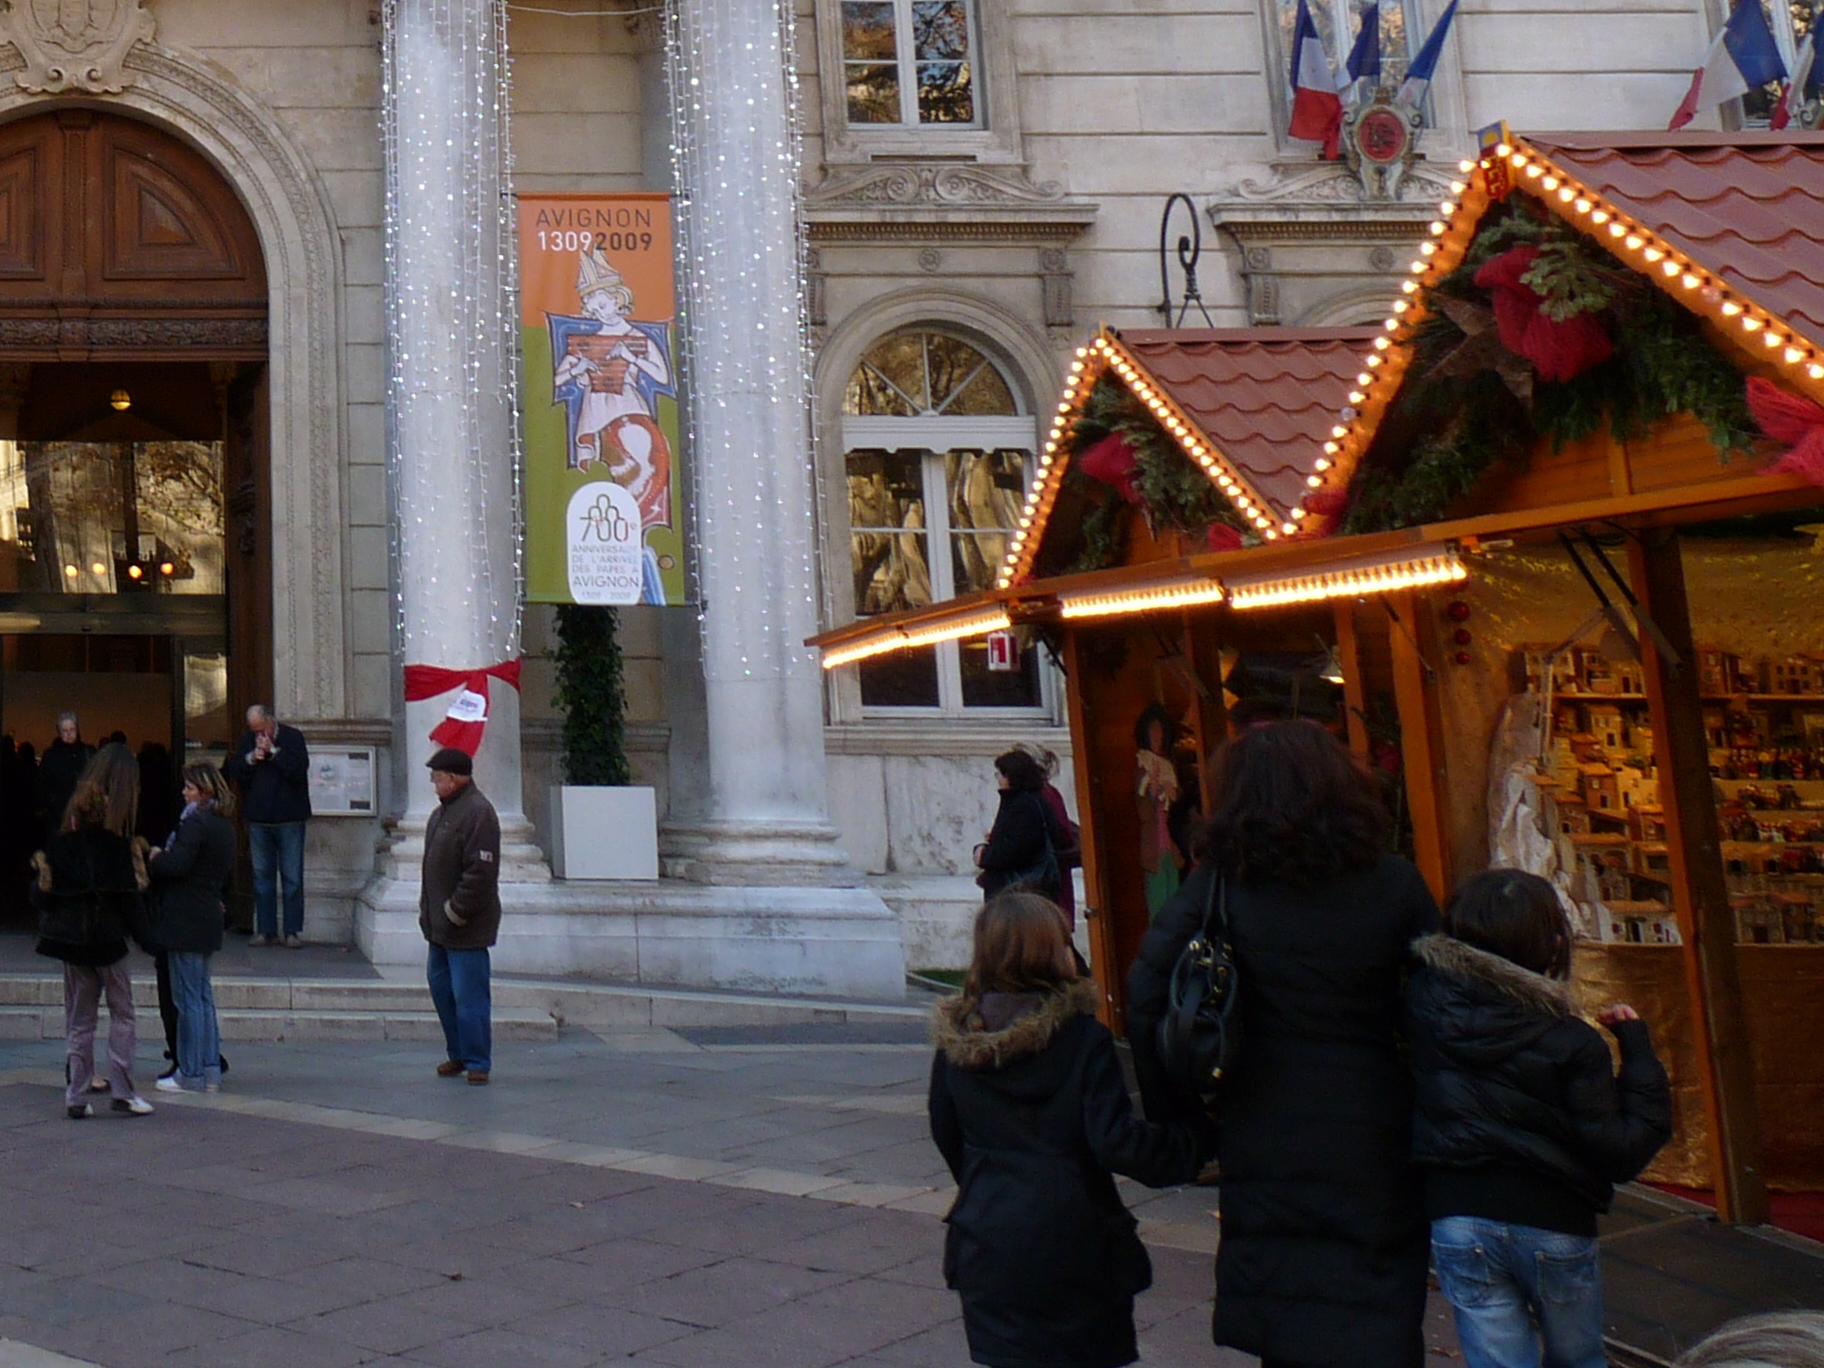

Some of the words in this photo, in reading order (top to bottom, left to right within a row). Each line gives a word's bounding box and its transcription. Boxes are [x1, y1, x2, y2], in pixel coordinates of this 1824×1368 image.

[536, 207, 651, 228] AVIGNON
[572, 554, 584, 564] DE
[572, 564, 590, 574] DES
[597, 564, 625, 574] PAPES
[573, 575, 640, 589] AVIGNON
